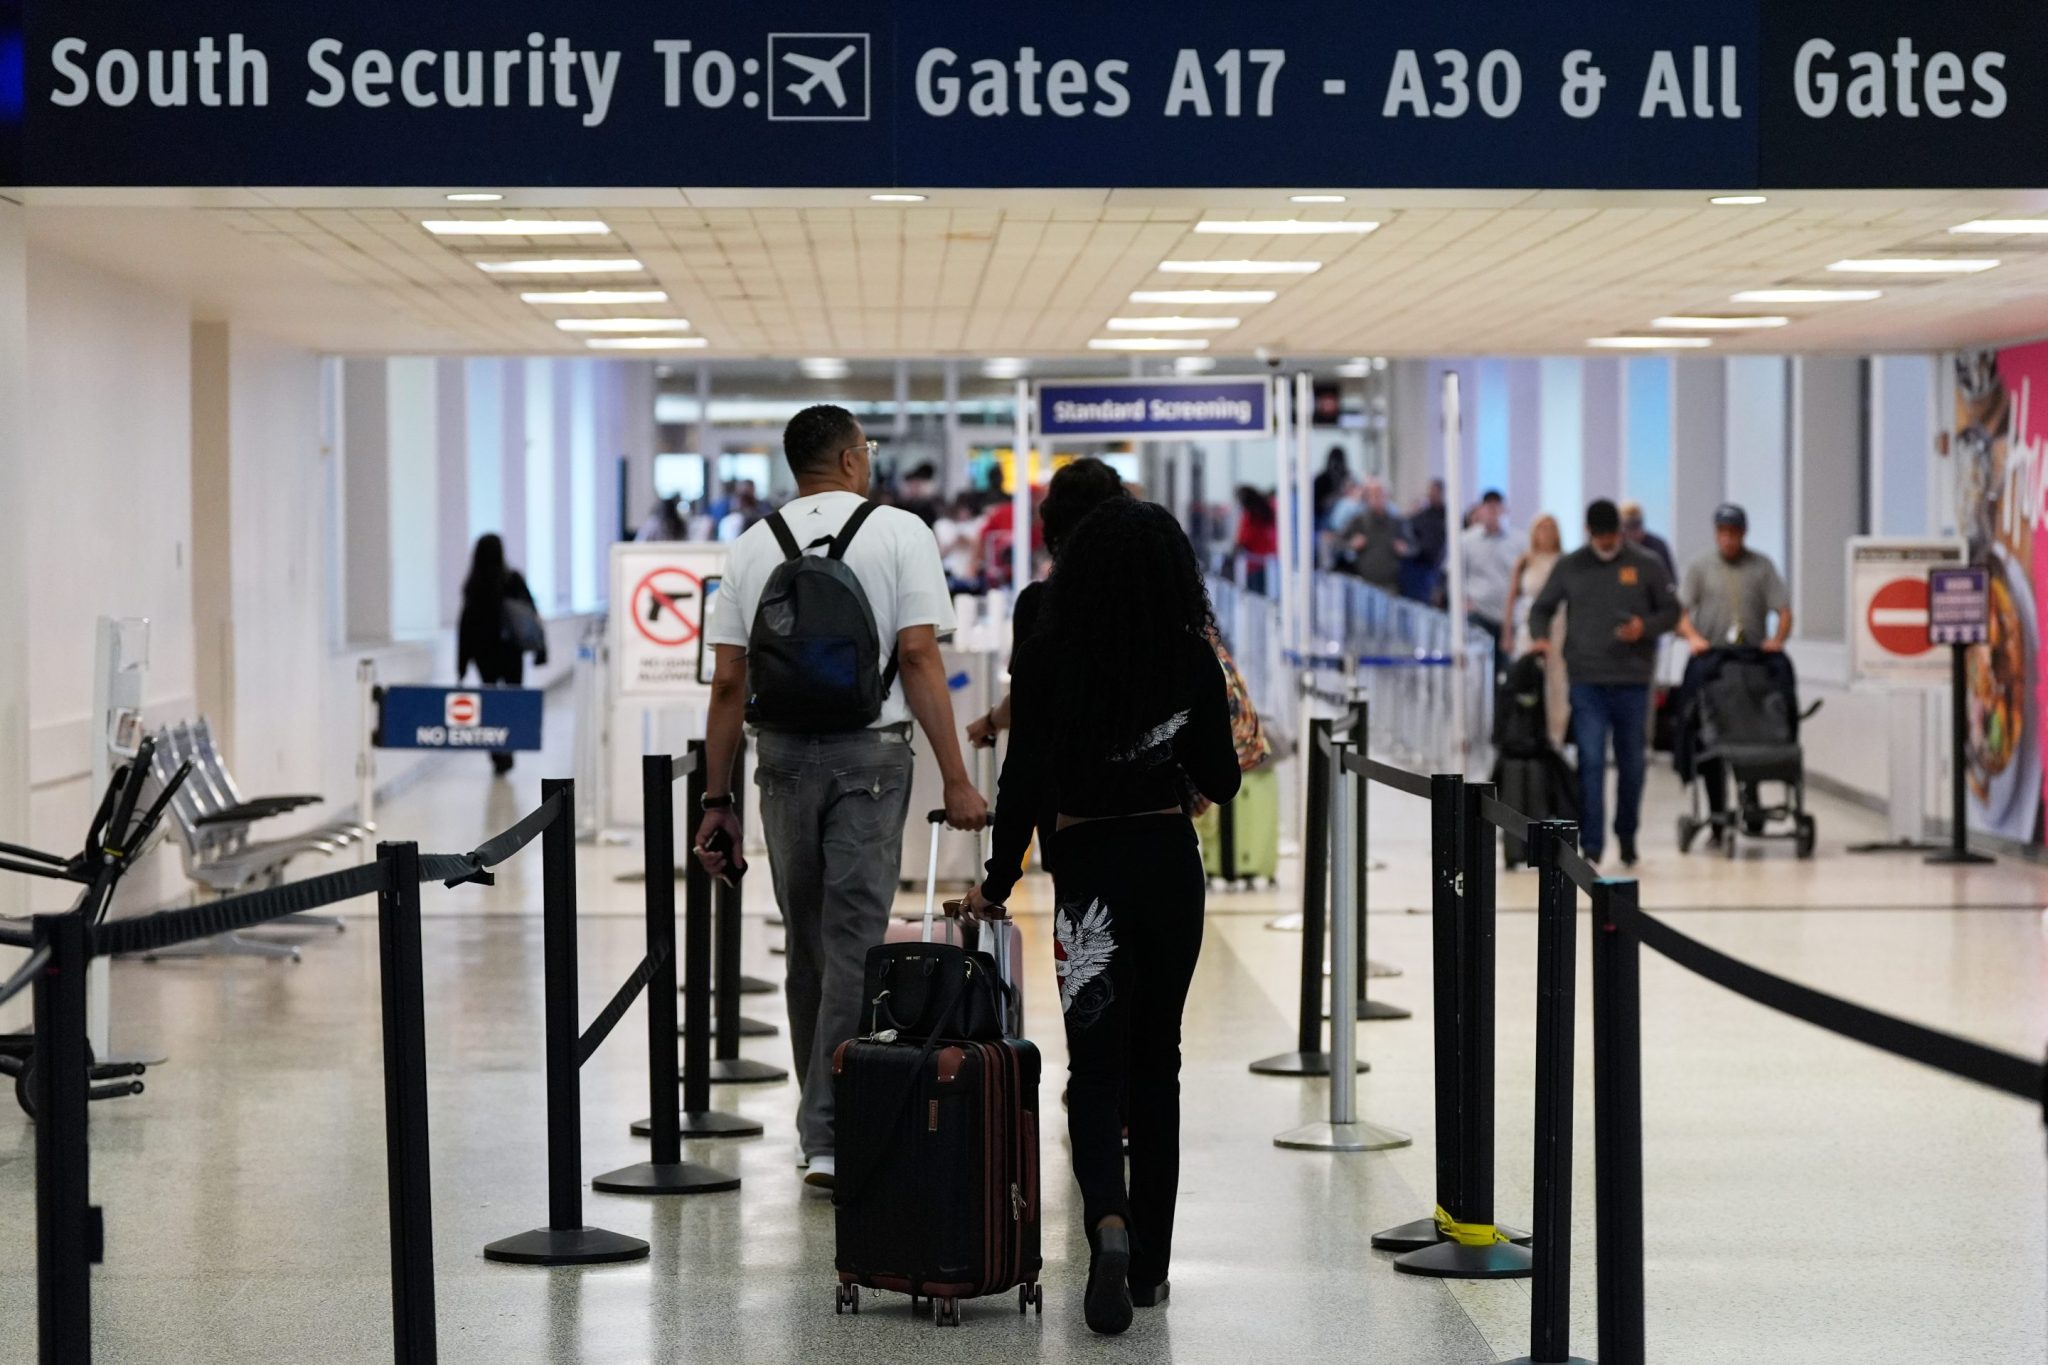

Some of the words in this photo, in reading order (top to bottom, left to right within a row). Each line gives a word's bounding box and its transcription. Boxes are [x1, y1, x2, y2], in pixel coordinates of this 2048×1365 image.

[50, 33, 269, 107] South
[306, 31, 621, 127] Security
[653, 39, 761, 108] To:
[915, 46, 1131, 118] Gates
[1163, 48, 1286, 117] A17
[1322, 79, 1346, 95] -
[1381, 48, 1522, 119] A30
[1559, 49, 1607, 119] &
[1638, 45, 1742, 119] All
[1793, 37, 2008, 119] Gates
[1054, 399, 1146, 422] Standard
[1149, 396, 1252, 425] Screening
[416, 726, 446, 746] NO
[448, 727, 508, 746] ENTRY
